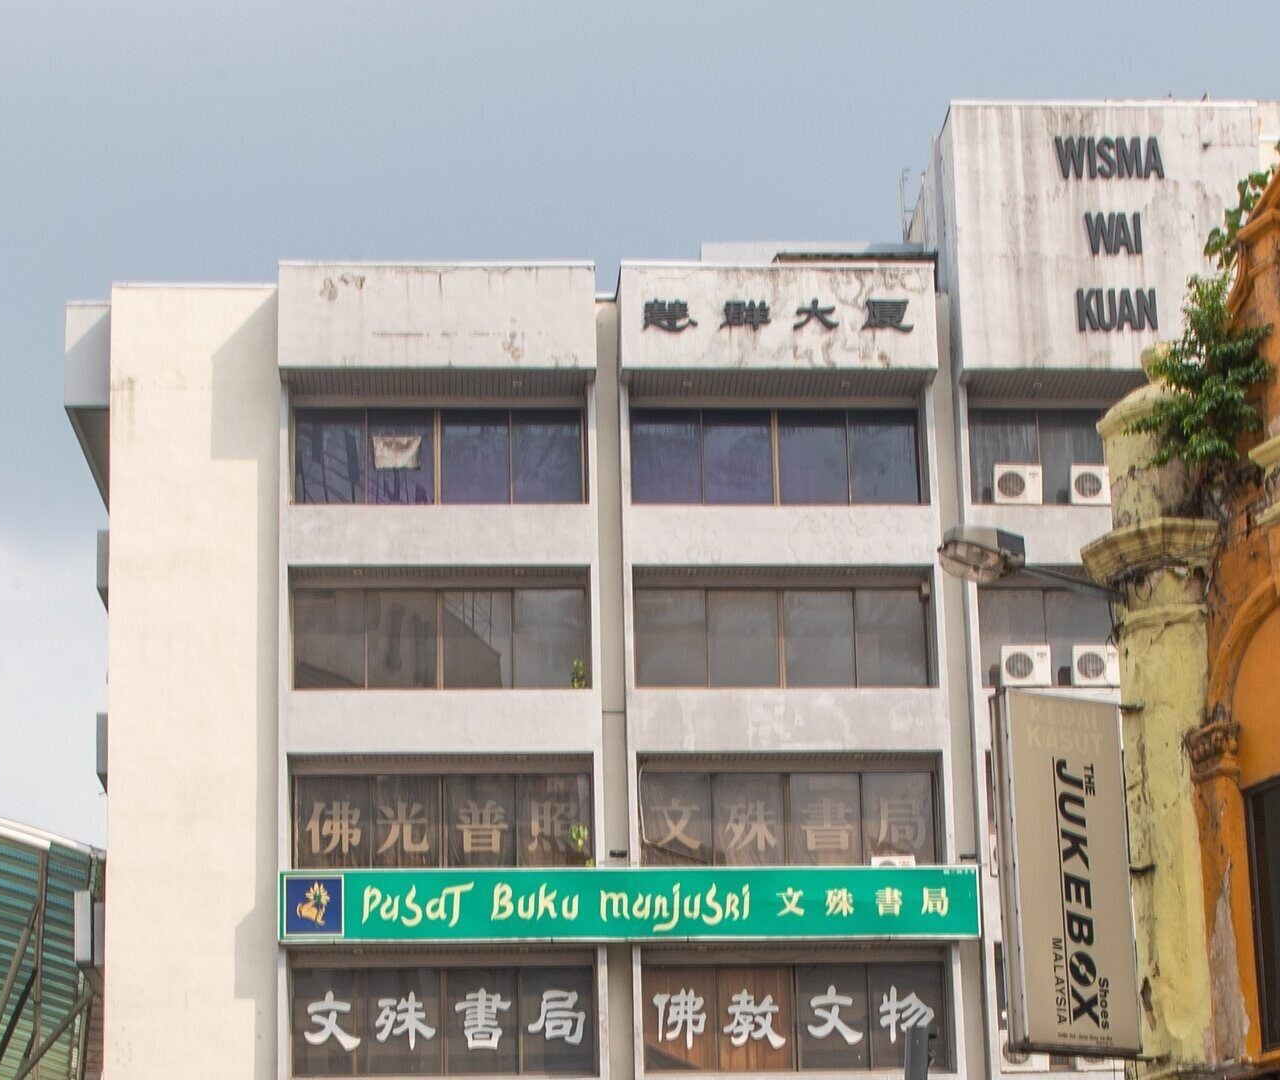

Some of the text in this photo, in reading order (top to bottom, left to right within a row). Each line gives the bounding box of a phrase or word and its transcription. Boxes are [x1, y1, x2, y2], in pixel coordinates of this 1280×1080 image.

[1054, 136, 1165, 181] WISMA
[1083, 211, 1143, 255] WAI
[1076, 287, 1158, 332] KUAN
[1026, 723, 1104, 756] KASUT
[1030, 701, 1100, 734] KEDAI
[1083, 763, 1096, 796] THE
[305, 800, 582, 853] 佛光普照
[650, 800, 927, 852] 文殊書局
[776, 887, 950, 918] 文殊書局
[1055, 758, 1101, 1029] JUKEBOX
[1052, 937, 1068, 1024] MALAYSIA
[1098, 977, 1110, 1030] Shoes
[303, 986, 587, 1052] 文殊書局
[654, 985, 934, 1051] 佛教文物
